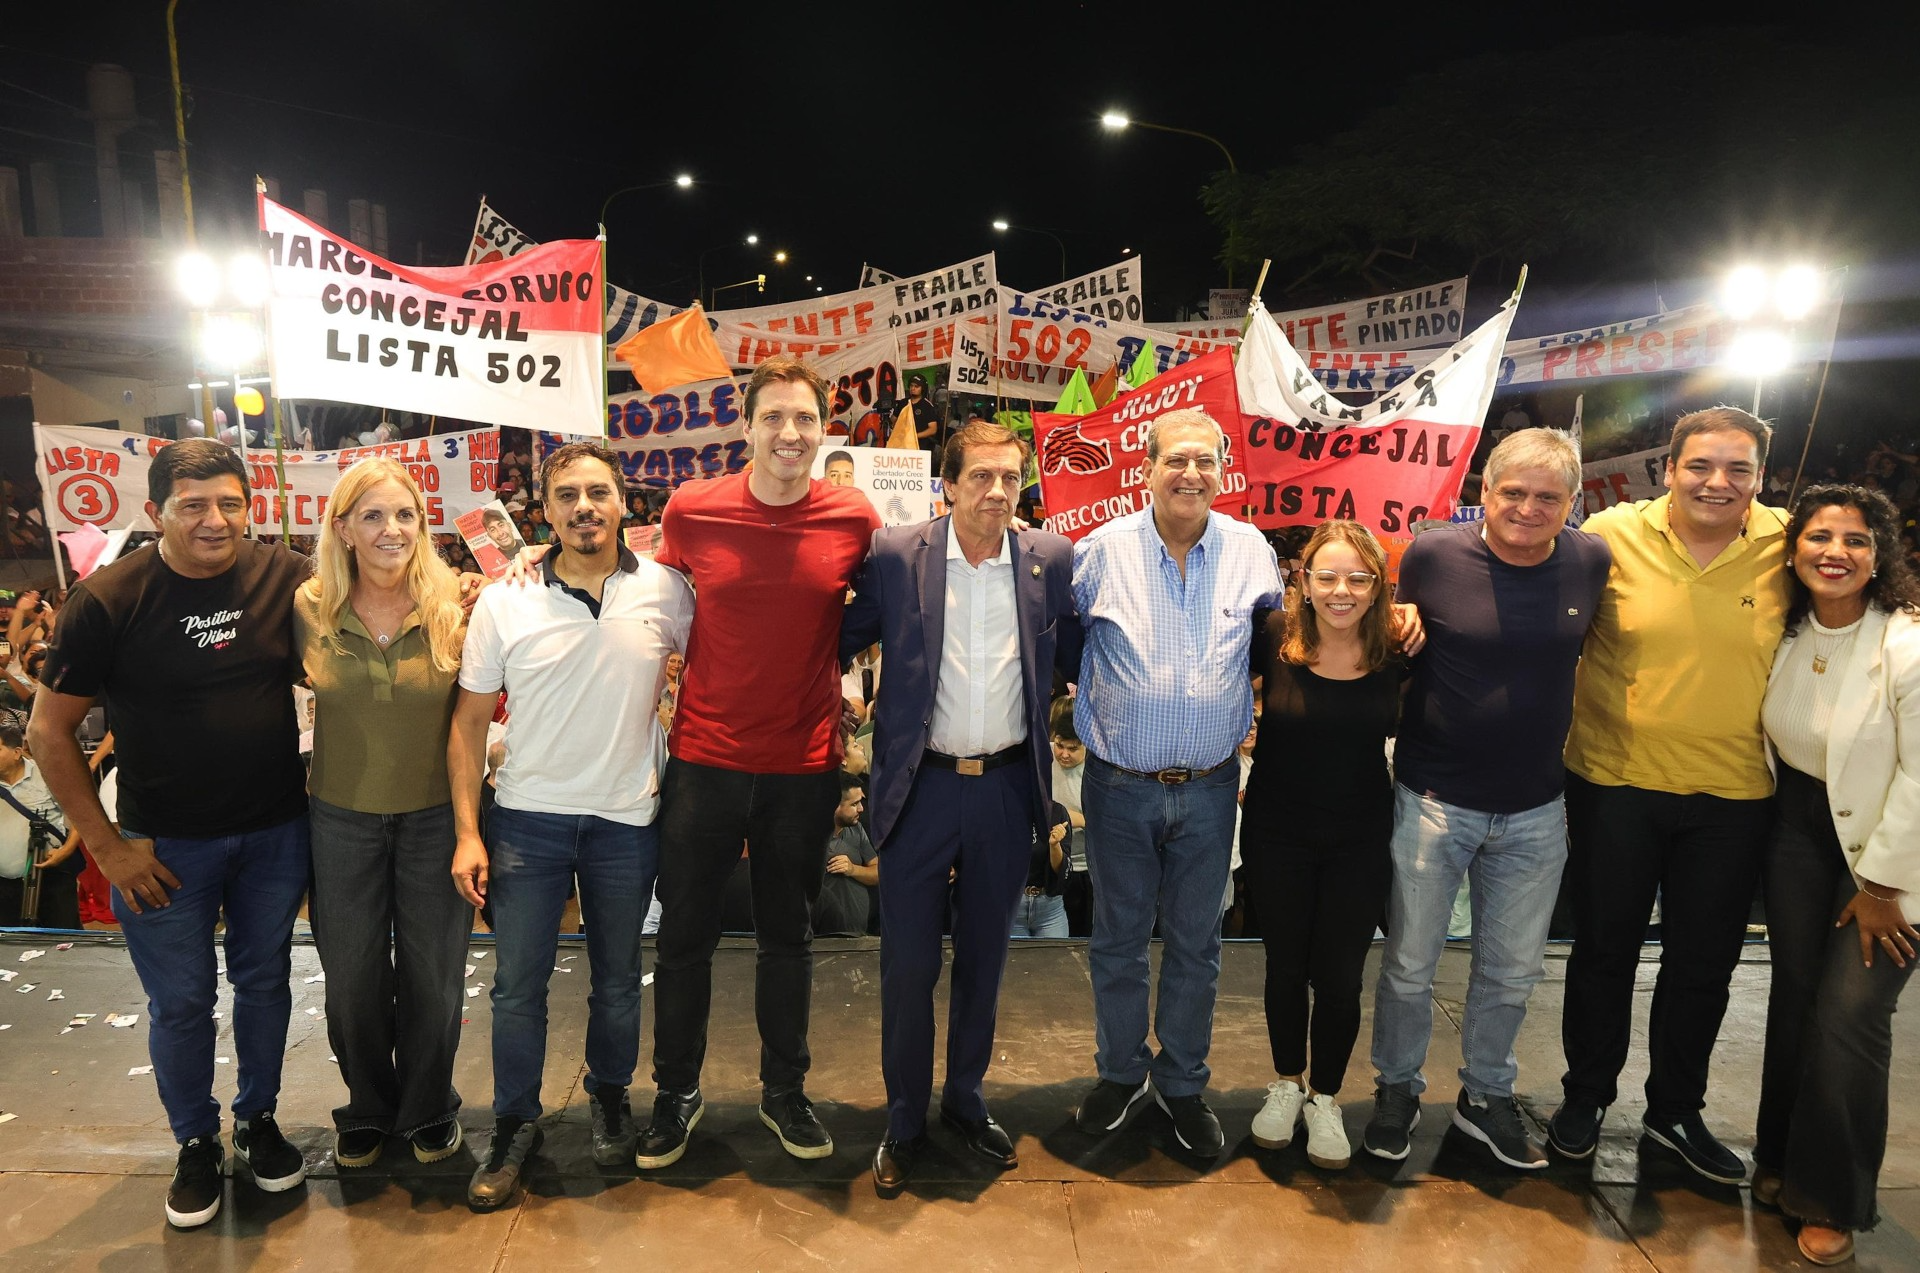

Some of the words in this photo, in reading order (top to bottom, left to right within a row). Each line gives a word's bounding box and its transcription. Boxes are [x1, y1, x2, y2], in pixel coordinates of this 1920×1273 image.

[895, 261, 987, 306] FRAILE
[1366, 285, 1453, 319] FRAILE
[321, 283, 528, 342] CONCEJAL
[888, 287, 998, 329] PINTADO
[1007, 319, 1092, 371] 502
[1358, 309, 1461, 345] PINTADO
[326, 329, 459, 378] LISTA
[487, 352, 561, 388] 502
[960, 335, 990, 372] LISTA
[607, 382, 749, 441] ROBLE
[1112, 375, 1204, 424] JUJUY
[1248, 417, 1457, 467] CONCEJAL
[45, 446, 121, 477] LISTA
[872, 469, 905, 477] Libertador
[873, 456, 923, 470] SUMATE
[74, 484, 103, 516] 3
[872, 478, 899, 490] CON
[900, 479, 923, 491] VOS
[1042, 492, 1136, 534] DIRECCION
[180, 610, 243, 635] Positive
[191, 627, 236, 648] Vibes
